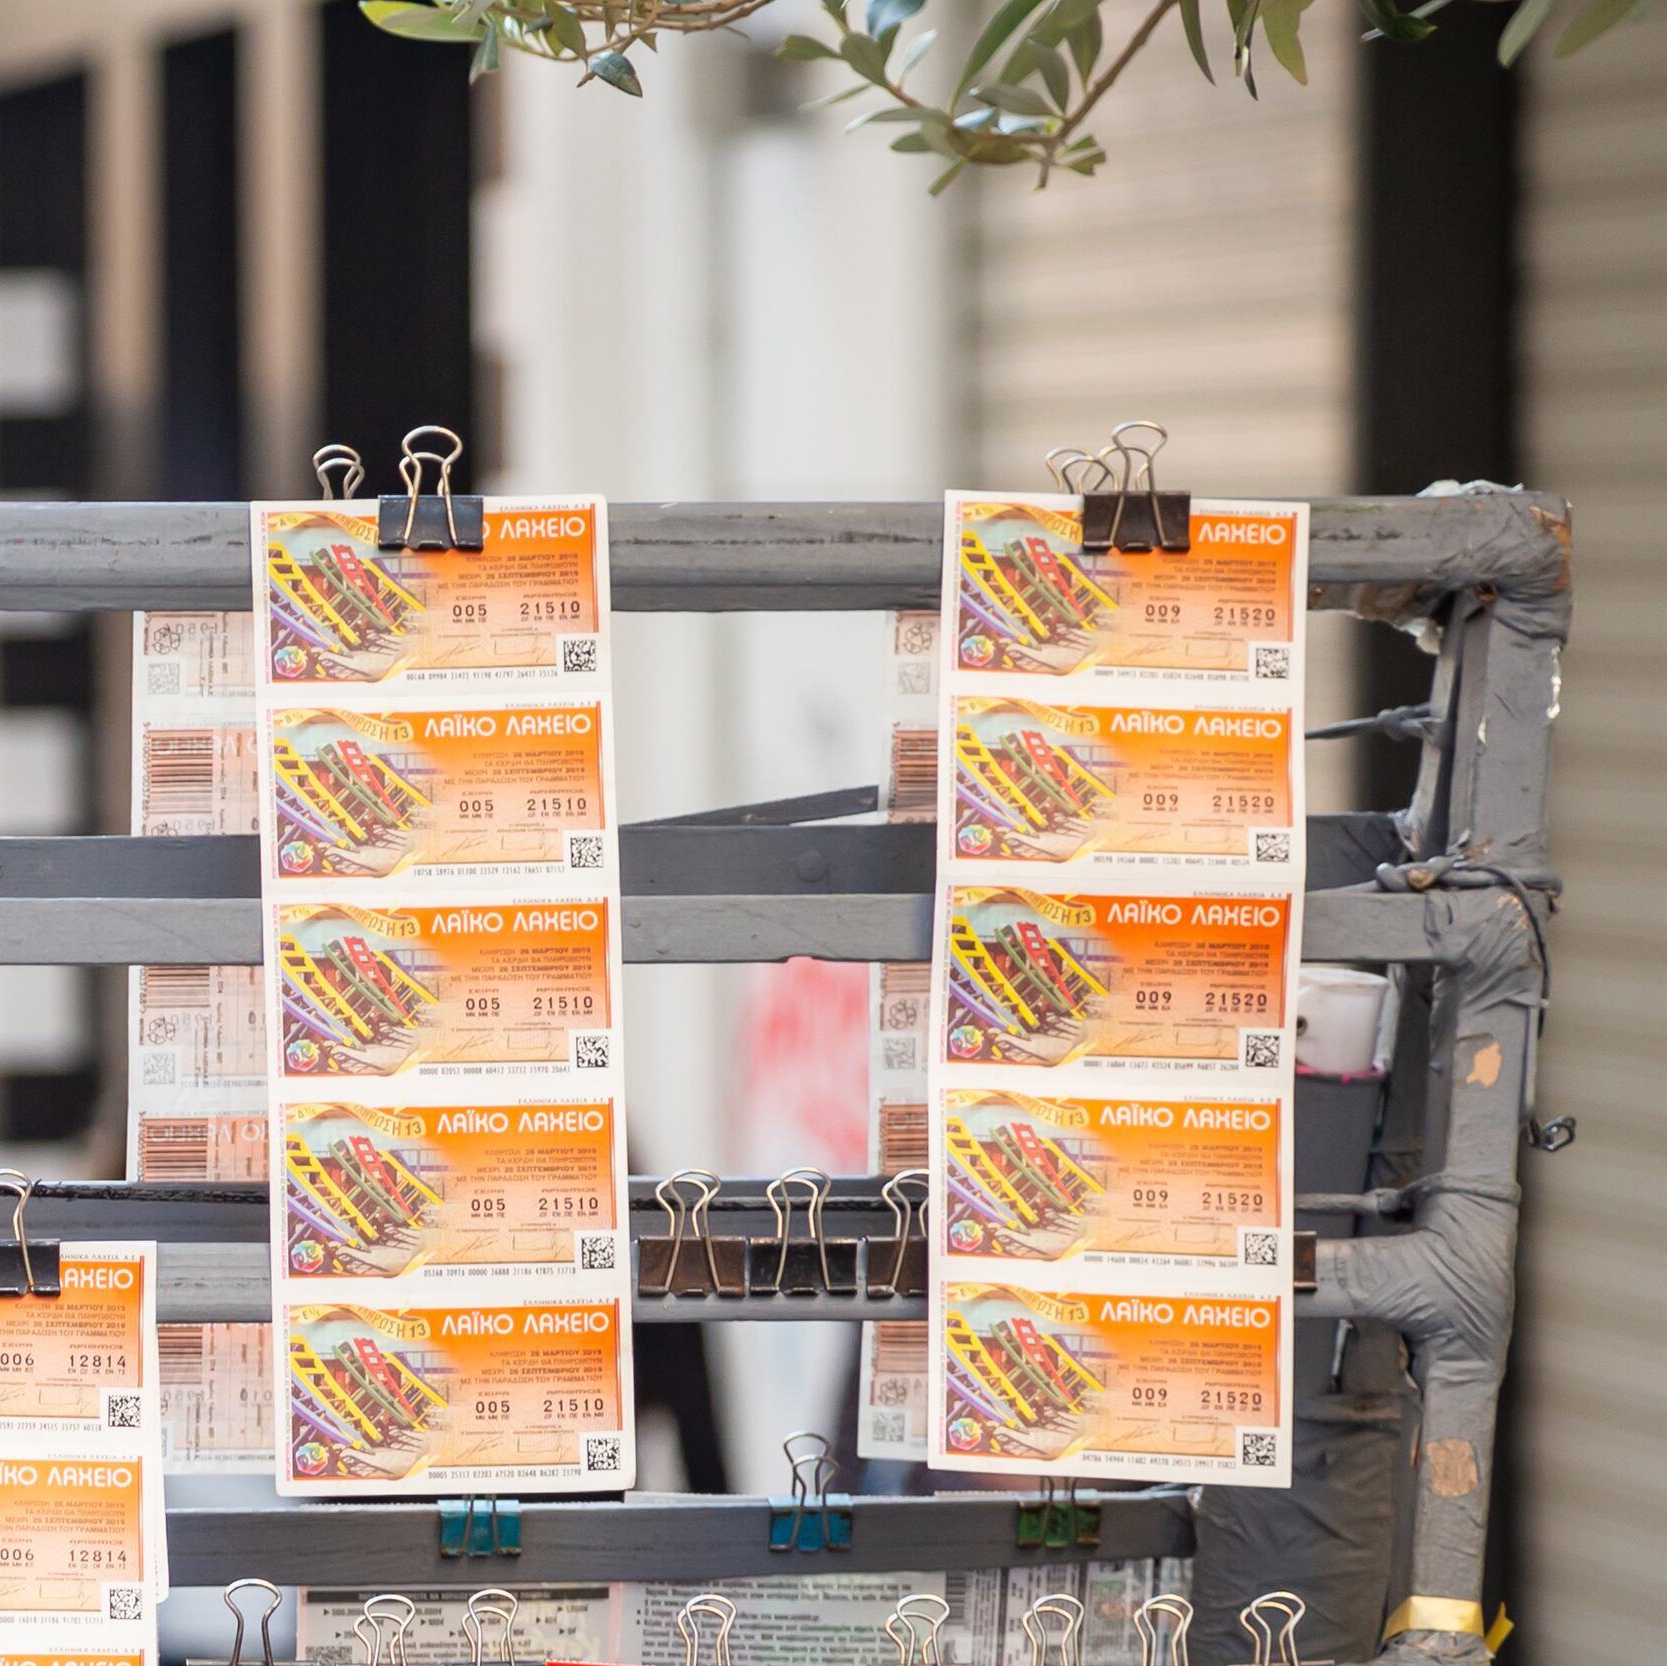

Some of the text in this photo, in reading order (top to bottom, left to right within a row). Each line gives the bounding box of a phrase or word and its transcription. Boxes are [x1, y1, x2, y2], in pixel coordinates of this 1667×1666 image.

[500, 516, 585, 539] ΛΑΧΕΙΟ
[1198, 523, 1285, 544] ΛΑΧΕΙΟ
[453, 602, 581, 616] 005 21510
[1145, 605, 1275, 620] 009 21520
[425, 714, 590, 737] ΛΑΪΚΟ ΛΑΧΕΙΟ
[1110, 711, 1281, 738] ΛΑΪΚΟ ΛΑΧΕΙΟ
[458, 798, 587, 813] 005 21510
[60, 1268, 135, 1290] ΑΧΕΙΟ
[1100, 1300, 1270, 1328] ΛΑΪΚΟ ΛΑΧΕΙΟ
[0, 1354, 127, 1369] 006 12814
[1132, 1387, 1261, 1404] 009 21520
